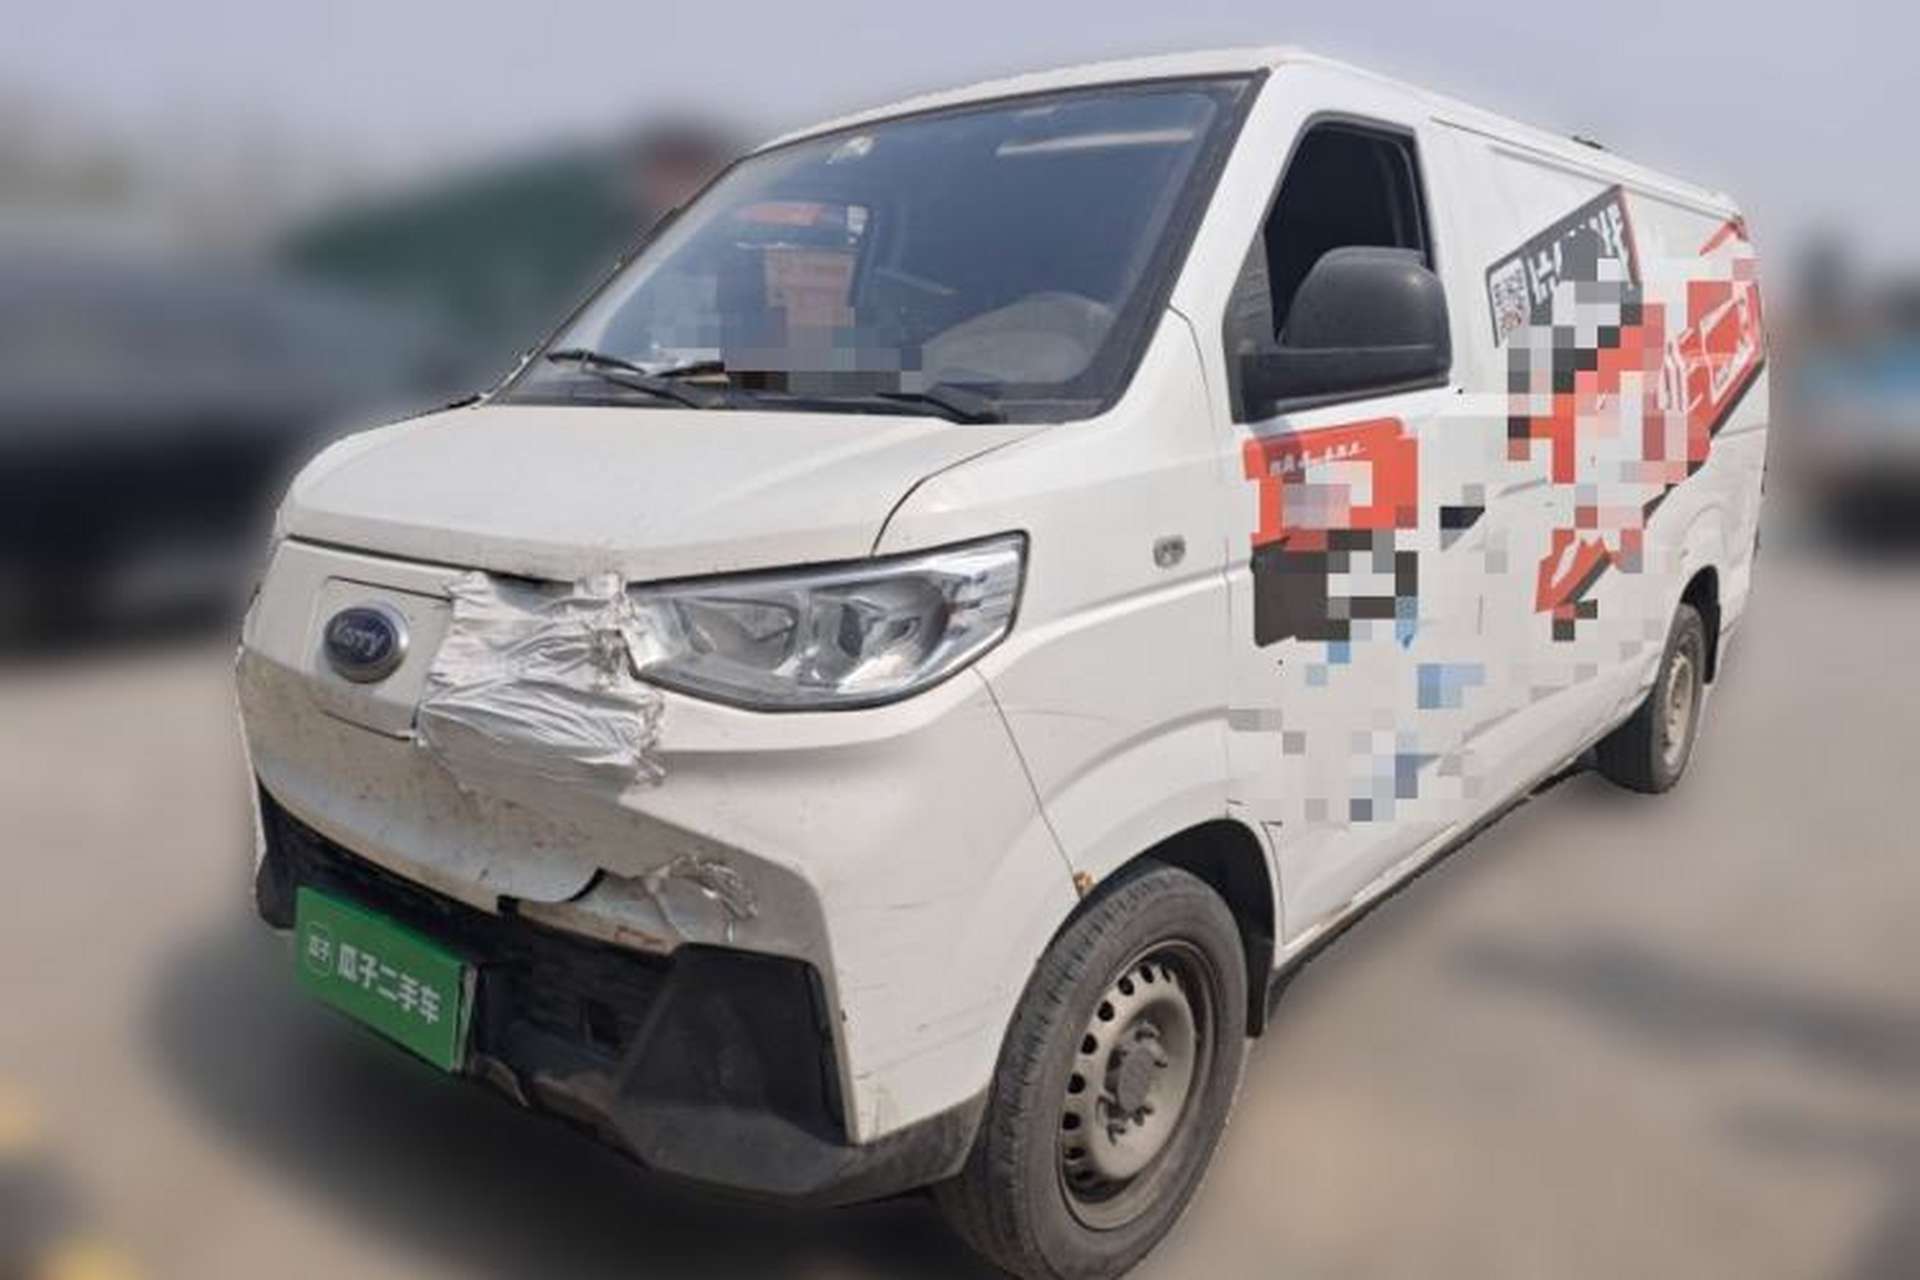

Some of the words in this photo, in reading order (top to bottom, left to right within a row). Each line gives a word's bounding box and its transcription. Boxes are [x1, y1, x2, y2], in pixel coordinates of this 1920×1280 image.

[337, 942, 440, 1024] 瓜子二手车
